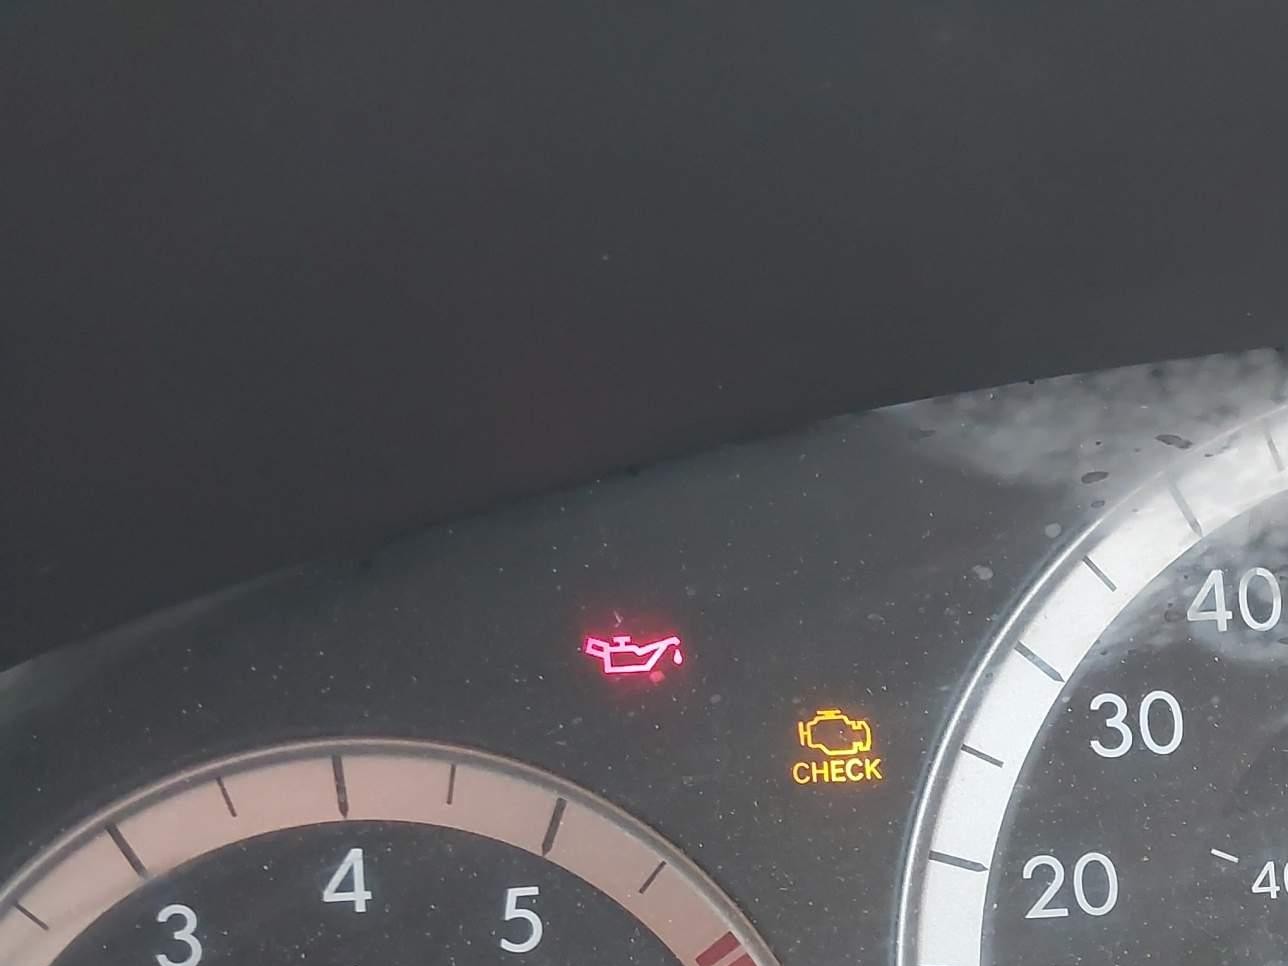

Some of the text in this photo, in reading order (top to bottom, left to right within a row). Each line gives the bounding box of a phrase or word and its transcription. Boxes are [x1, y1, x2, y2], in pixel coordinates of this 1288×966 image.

[1187, 567, 1282, 632] 40
[1089, 690, 1183, 758] 30
[793, 760, 882, 784] CHECK
[322, 848, 372, 913] 4
[1022, 852, 1119, 919] 20
[500, 886, 543, 953] 5
